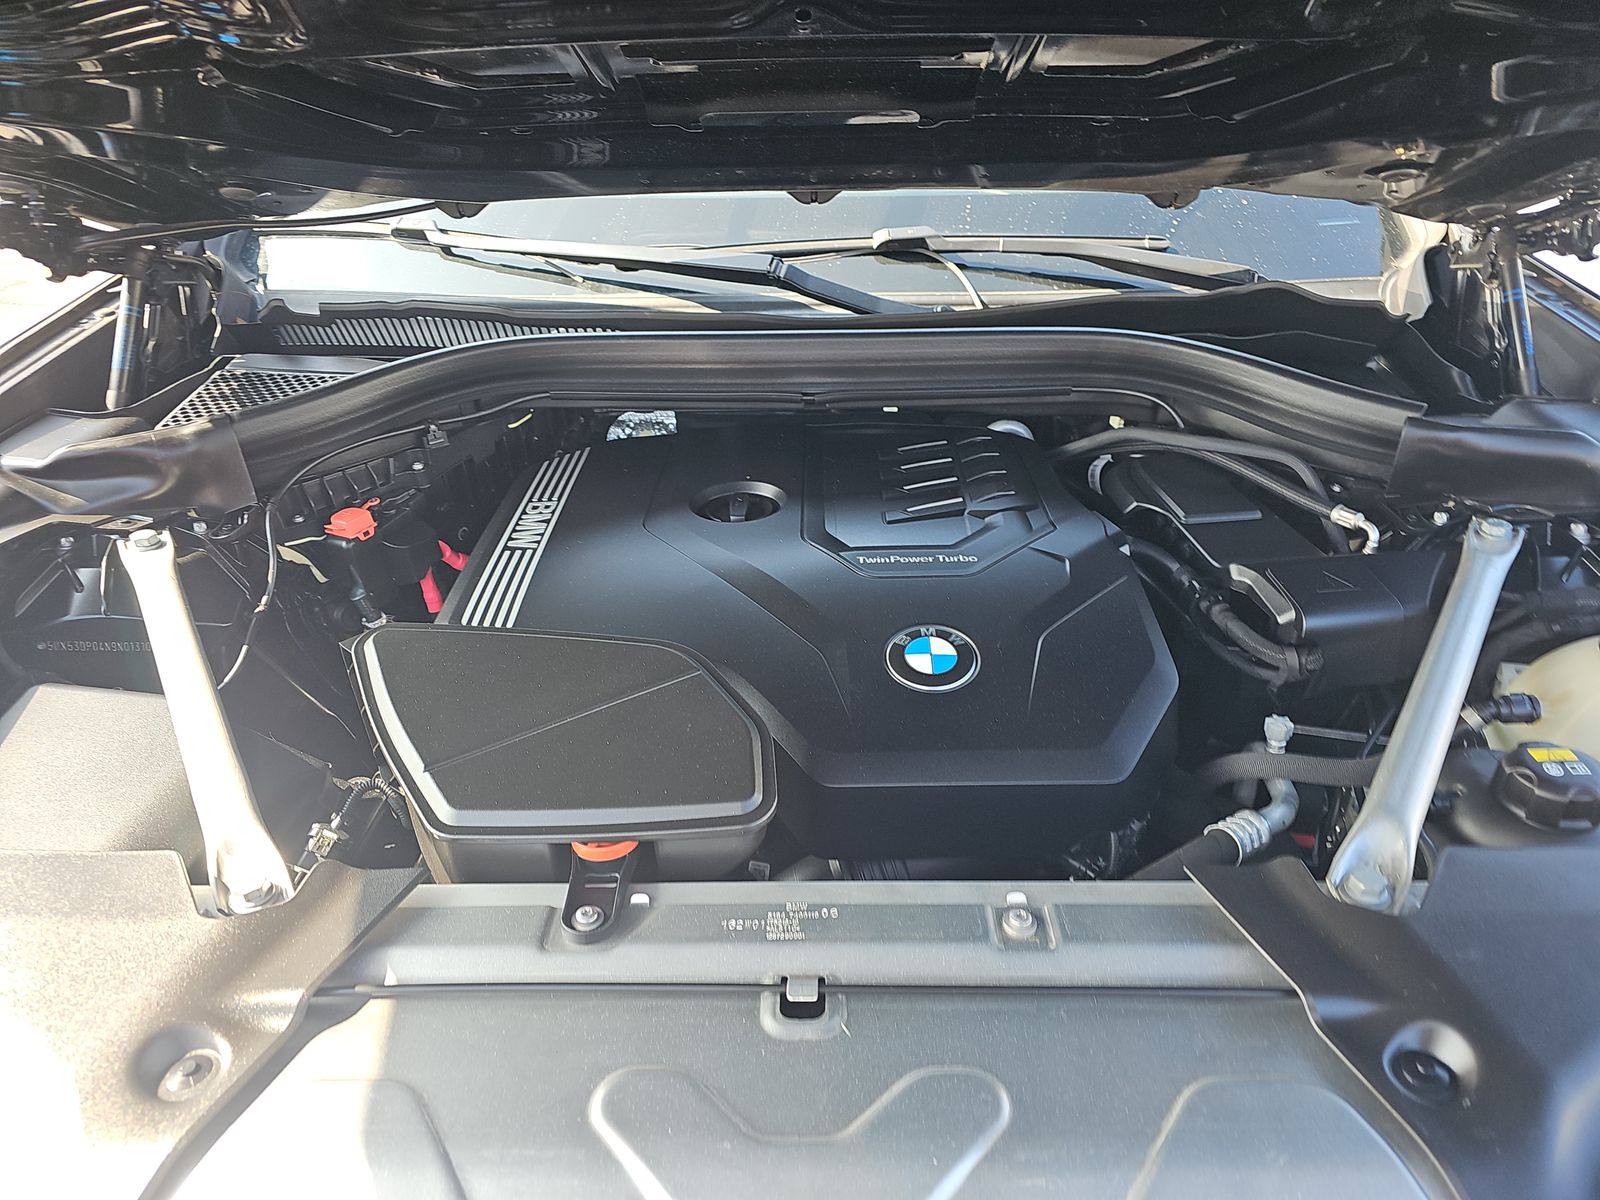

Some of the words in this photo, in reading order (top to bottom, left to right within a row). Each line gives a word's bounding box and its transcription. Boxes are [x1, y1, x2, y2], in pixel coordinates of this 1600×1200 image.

[506, 500, 559, 548] BMW
[856, 555, 935, 564] TwinPower
[935, 554, 979, 563] Turbo
[894, 627, 966, 647] BMW
[785, 901, 808, 912] BMW
